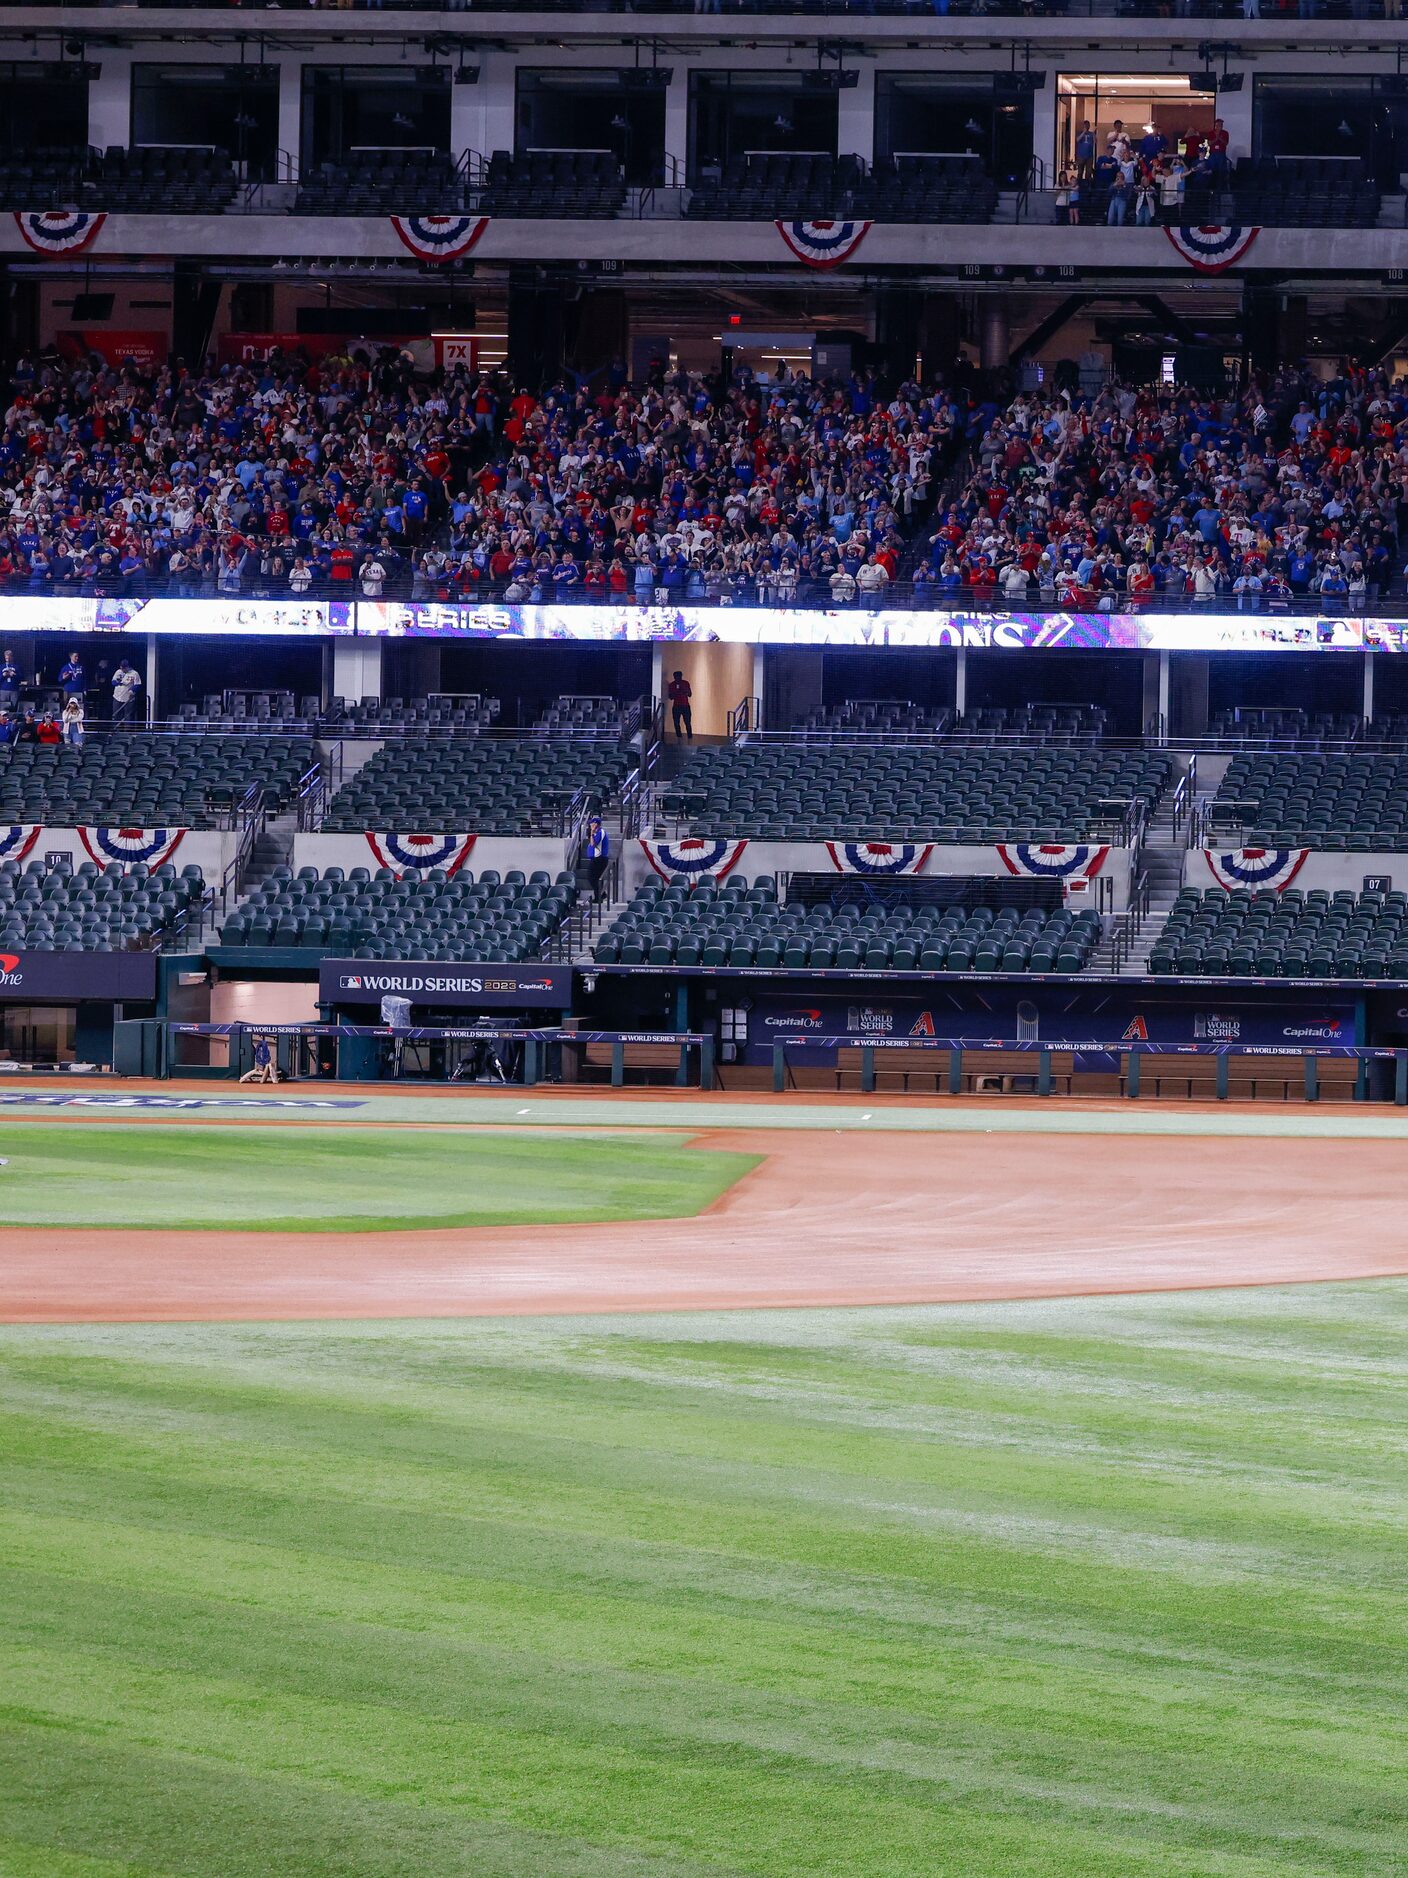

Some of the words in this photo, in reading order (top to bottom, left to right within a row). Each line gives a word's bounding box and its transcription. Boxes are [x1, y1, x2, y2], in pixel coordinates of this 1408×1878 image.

[601, 260, 617, 271] 109
[963, 264, 981, 275] 109
[1058, 265, 1075, 276] 108
[1387, 269, 1404, 279] 108
[447, 345, 466, 358] 7X
[1369, 879, 1381, 890] 07
[363, 976, 424, 991] WORLD
[425, 978, 482, 993] SERIES
[484, 981, 517, 990] 2023
[861, 1014, 893, 1023] WORLD
[278, 1026, 301, 1034] SERIES
[860, 1022, 893, 1031] SERIES
[1207, 1021, 1240, 1029] WORLD
[1207, 1029, 1240, 1038] SERIES
[860, 1039, 886, 1047] WORLD
